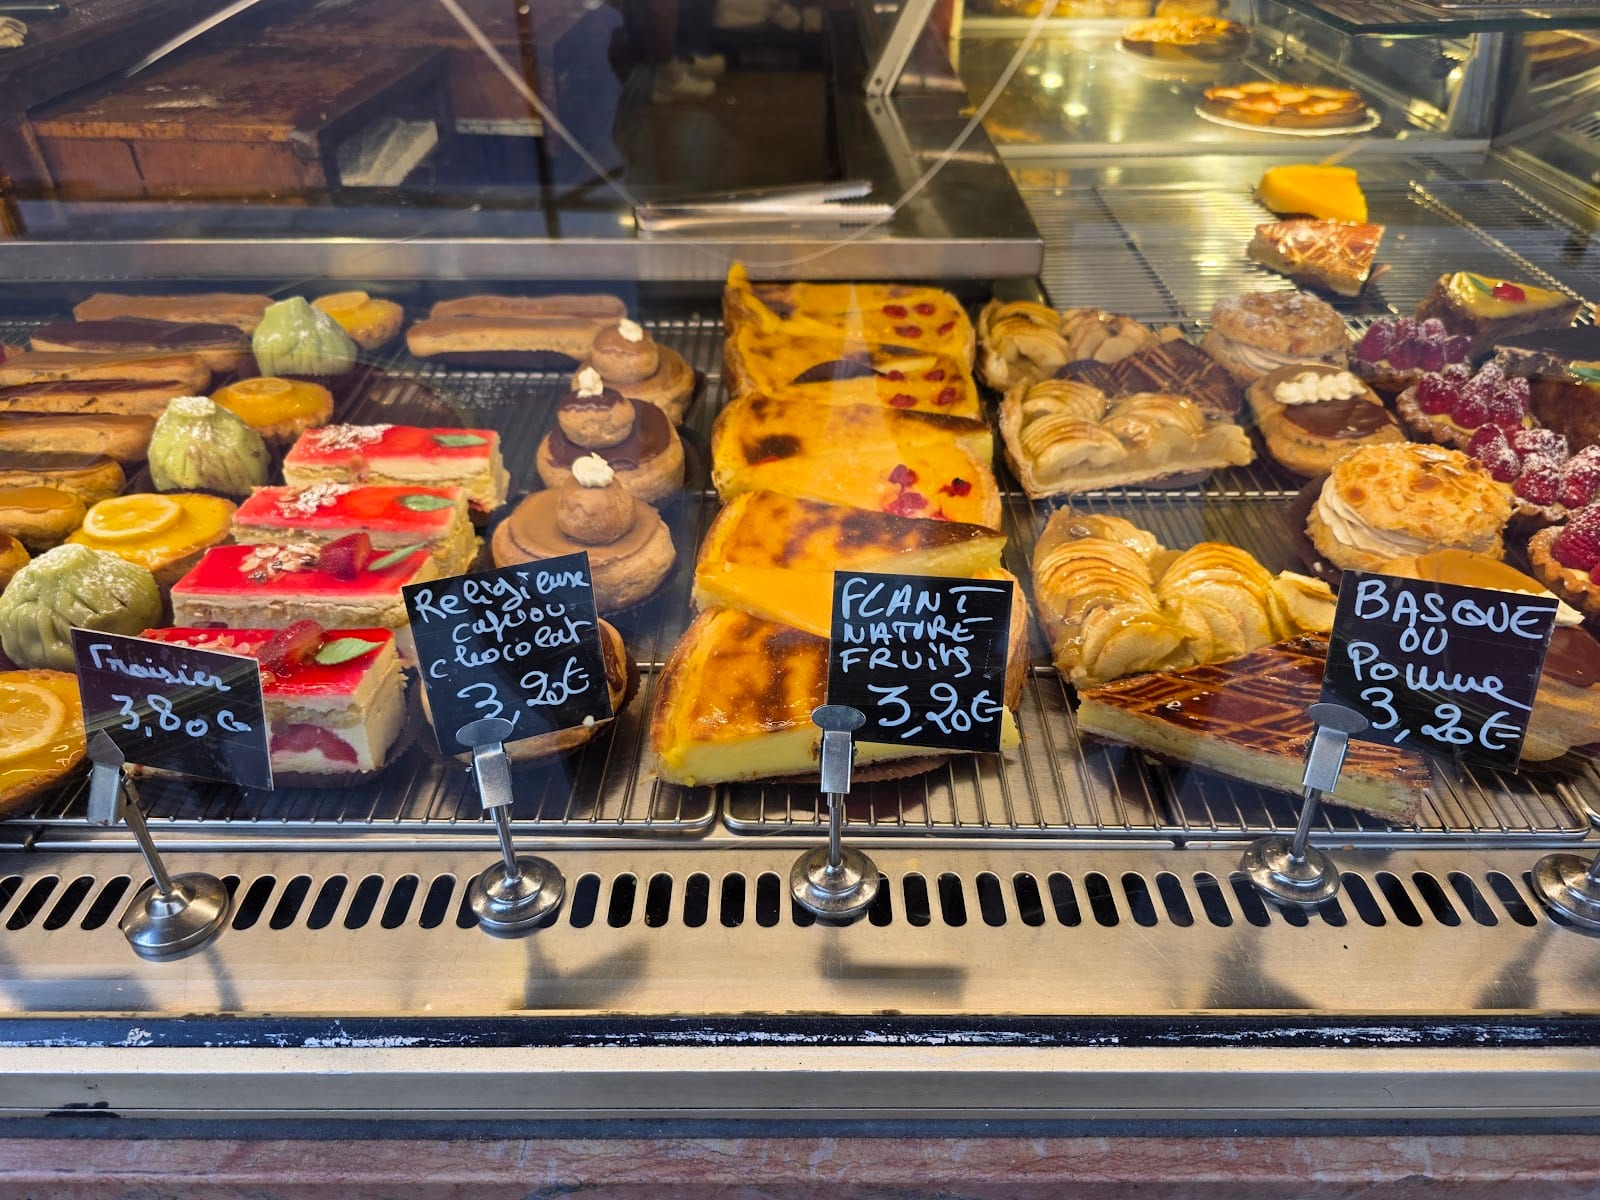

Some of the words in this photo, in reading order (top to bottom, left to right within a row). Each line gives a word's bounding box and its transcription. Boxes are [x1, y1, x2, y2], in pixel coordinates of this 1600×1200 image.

[843, 615, 993, 645] NATURE
[1354, 579, 1557, 639] BASQUE
[430, 616, 592, 679] chocolat
[1399, 626, 1449, 656] OU
